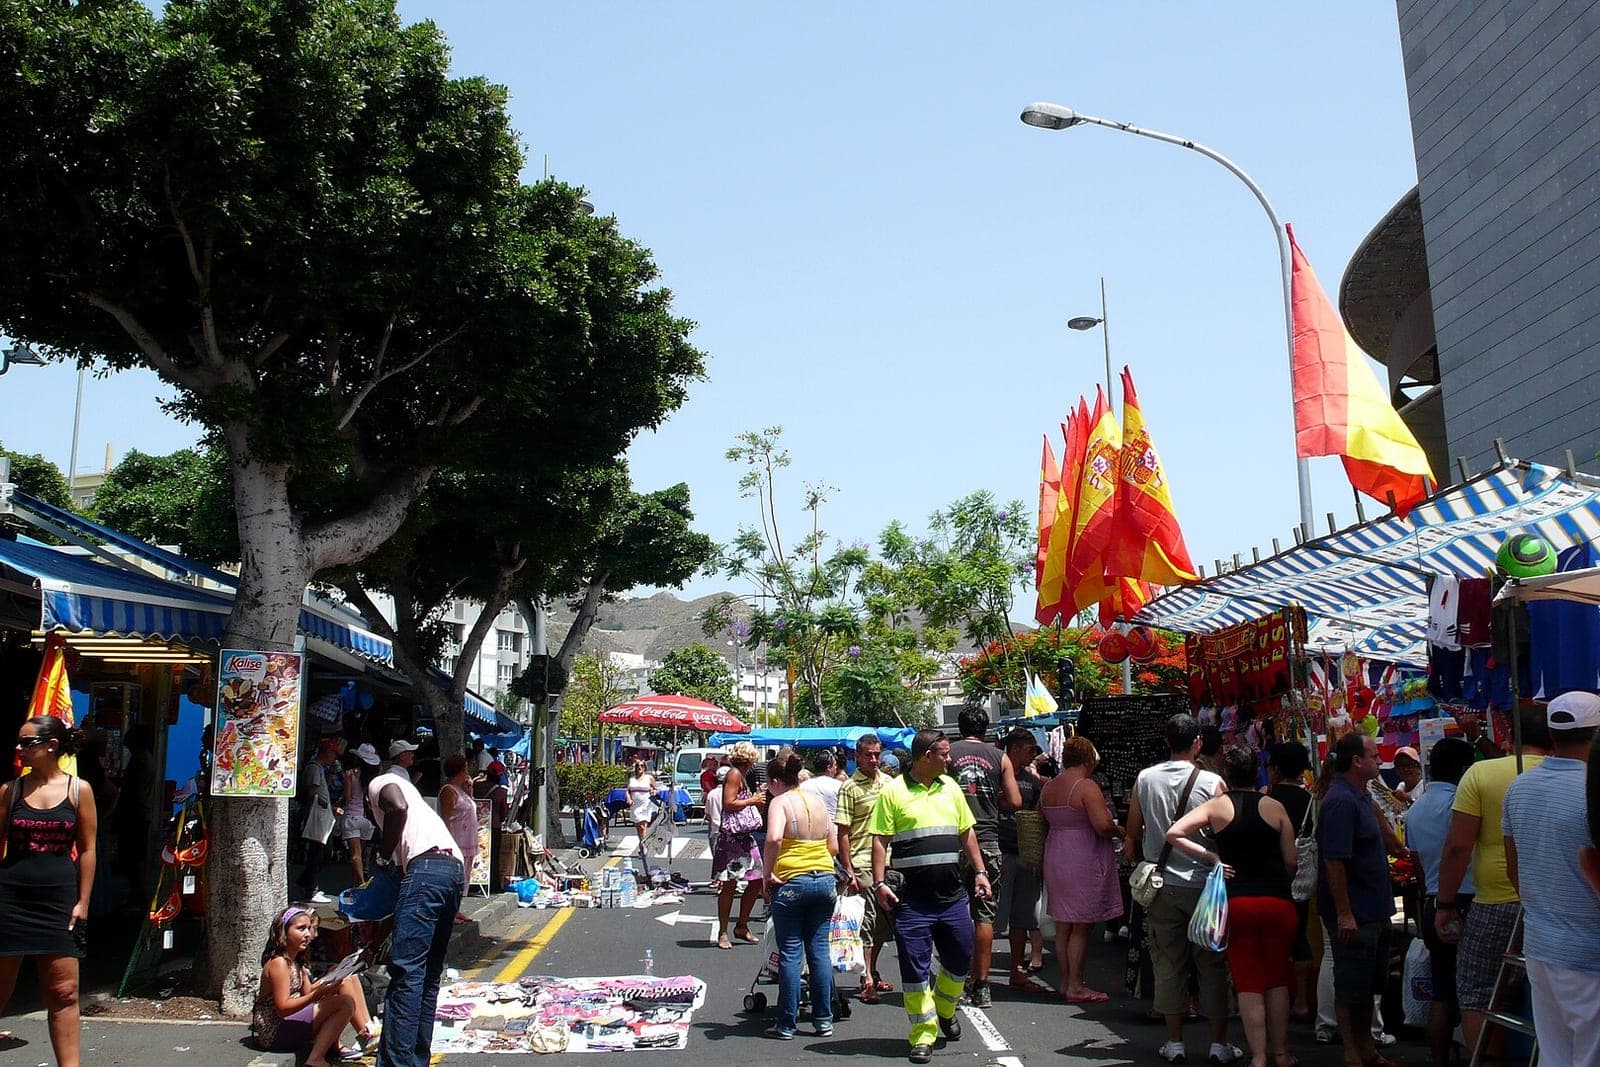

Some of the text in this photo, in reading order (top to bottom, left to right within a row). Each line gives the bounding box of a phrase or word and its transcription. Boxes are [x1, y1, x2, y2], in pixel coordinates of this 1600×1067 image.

[227, 656, 262, 673] Kalise
[639, 706, 688, 719] CocaCola
[692, 711, 732, 726] CocaCola
